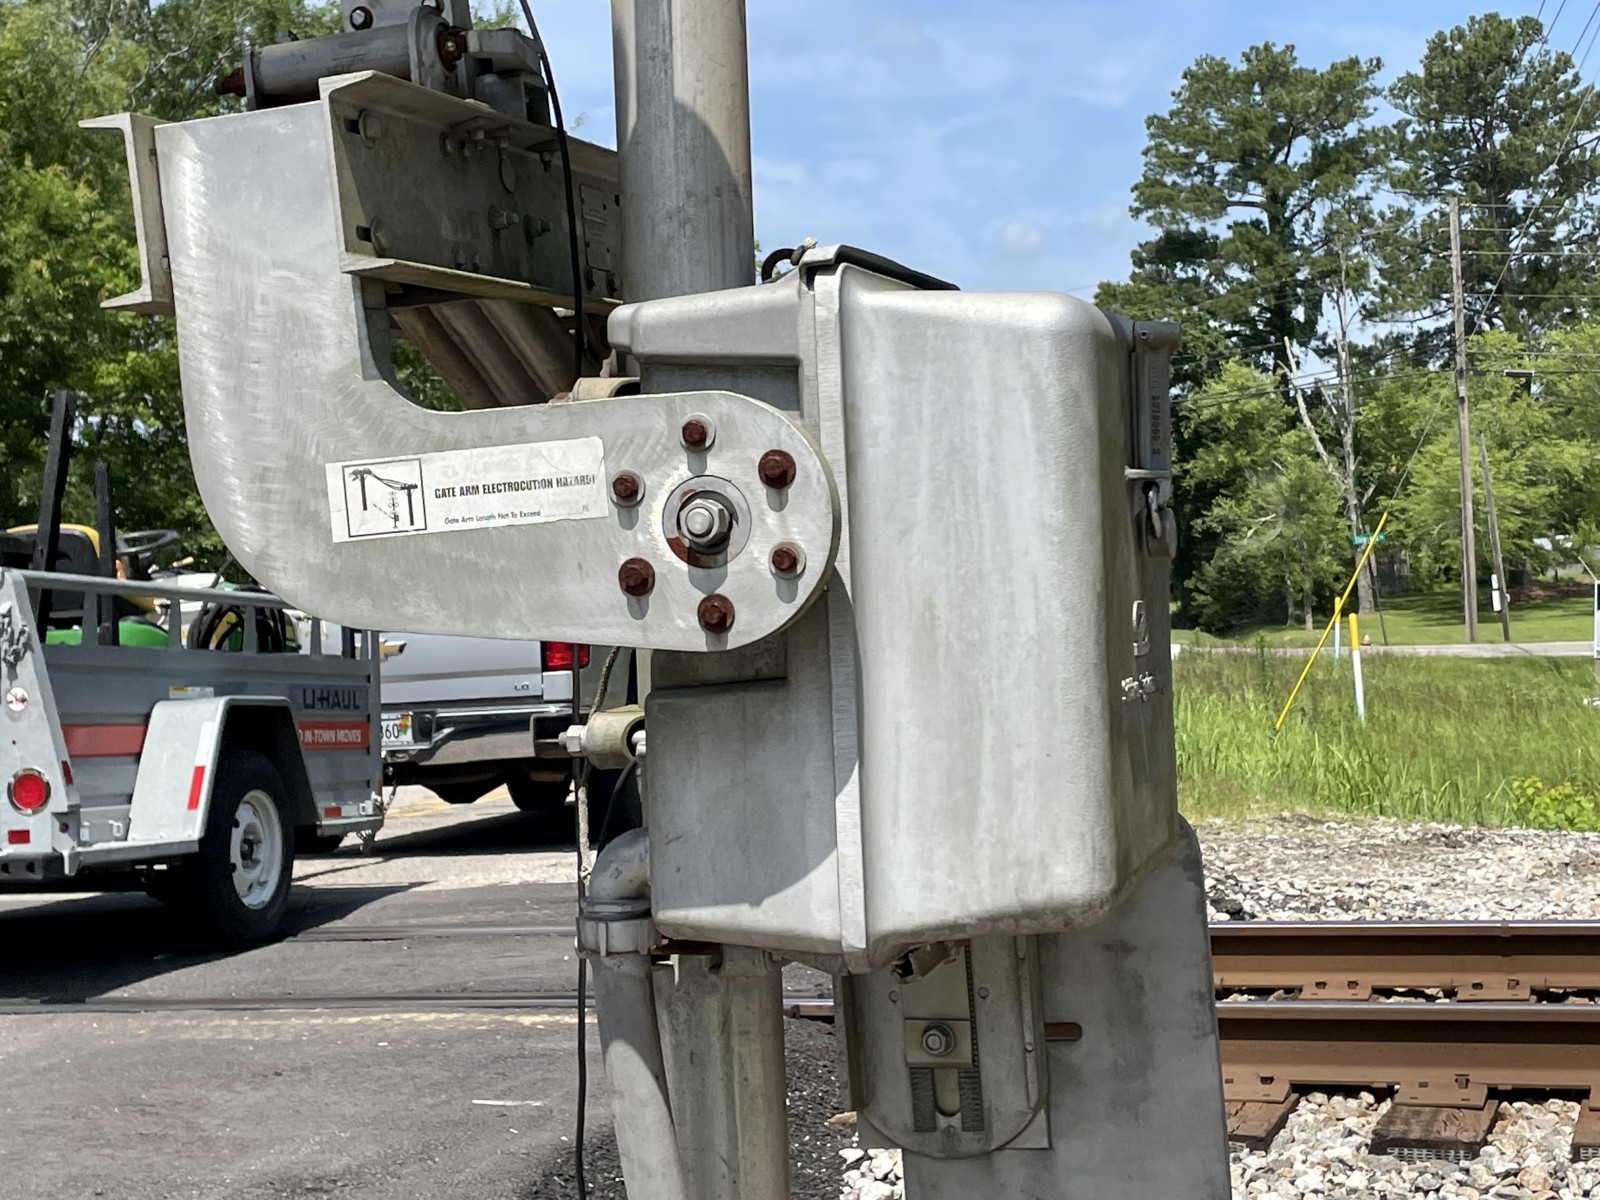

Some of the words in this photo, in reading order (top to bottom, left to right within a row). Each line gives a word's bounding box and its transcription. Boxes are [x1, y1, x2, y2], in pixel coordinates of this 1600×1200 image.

[434, 487, 457, 499] GATE
[459, 484, 480, 496] ARM
[482, 478, 554, 495] ELECTROCUTION
[444, 516, 460, 525] Gate
[461, 515, 475, 523] Arm
[475, 512, 496, 523] Length
[497, 511, 510, 520] Not
[510, 511, 518, 519] To
[519, 510, 541, 518] Exceed
[303, 688, 360, 709] U-HAUL
[304, 729, 336, 744] IN-TOWN
